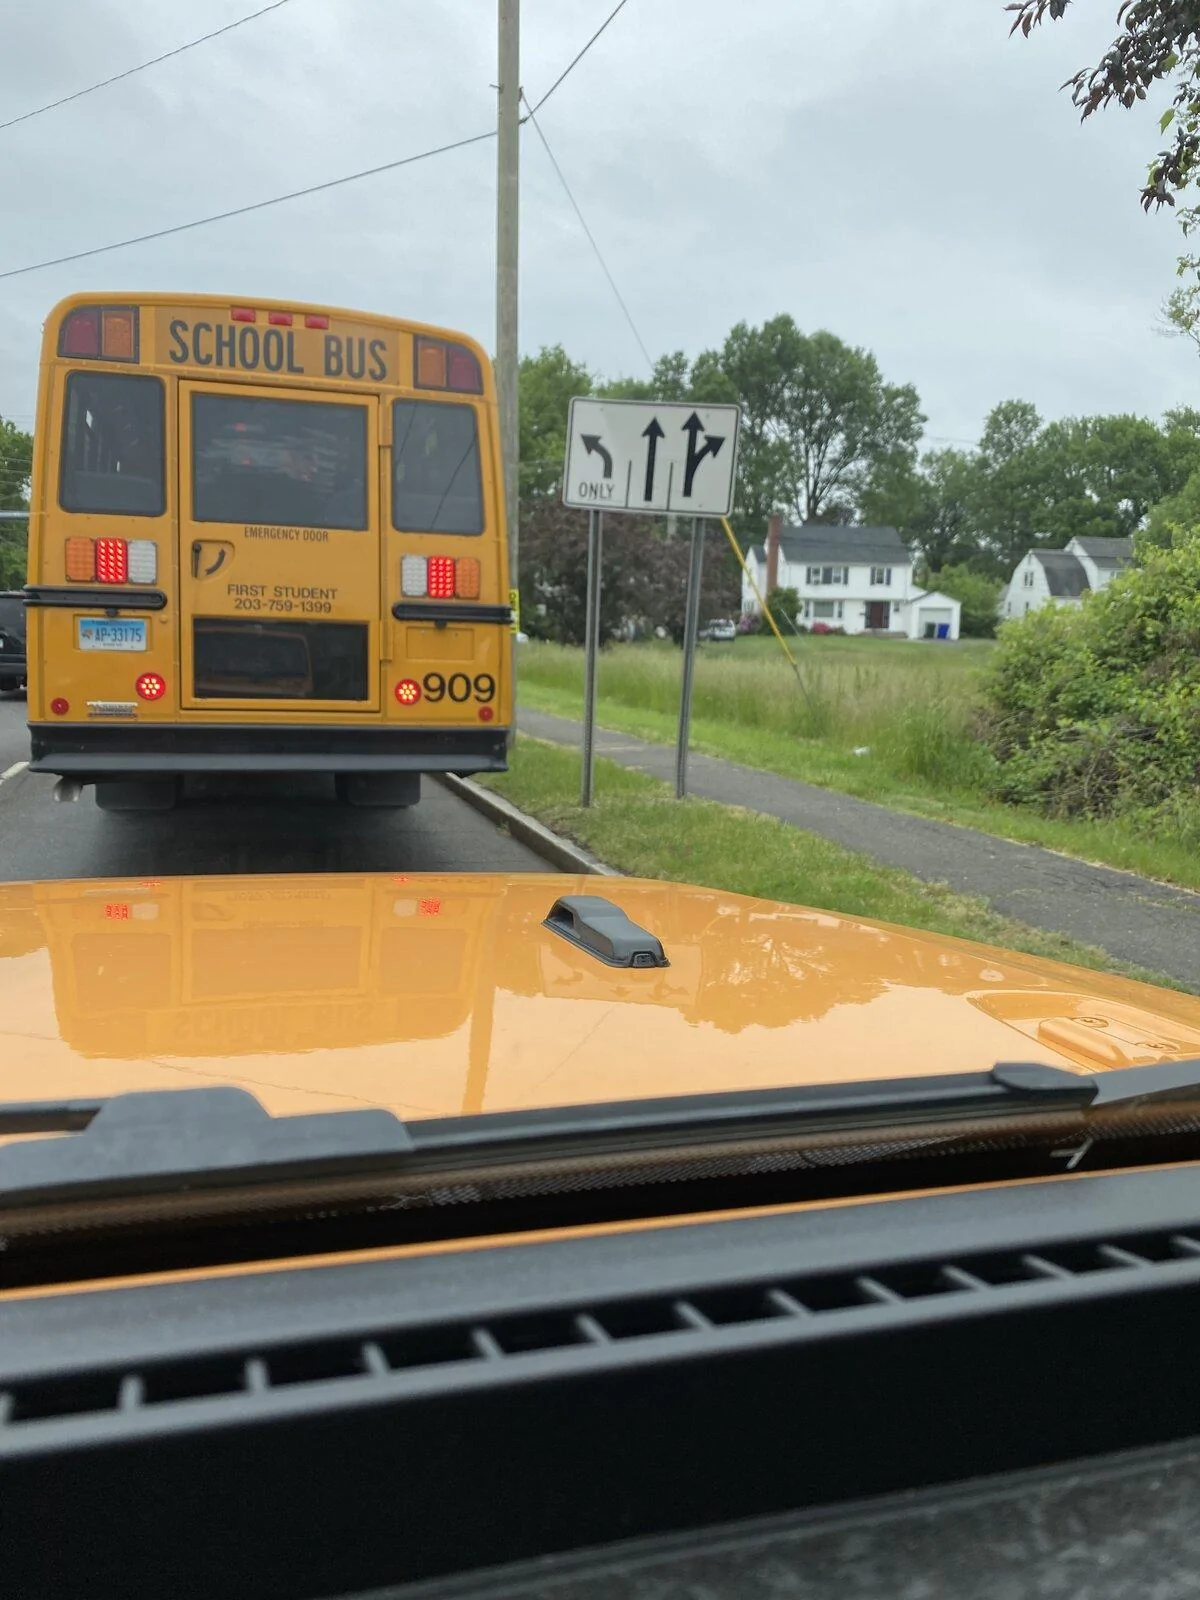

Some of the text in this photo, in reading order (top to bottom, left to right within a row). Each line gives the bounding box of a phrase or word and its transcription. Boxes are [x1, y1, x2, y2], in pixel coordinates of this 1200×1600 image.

[169, 320, 388, 381] SCHOOL BUS
[578, 482, 615, 499] ONLY
[244, 527, 329, 542] EMERGENCY DOOR
[227, 584, 338, 600] FIRST STUDENT
[234, 598, 332, 613] 203-759-1399
[423, 672, 496, 703] 909
